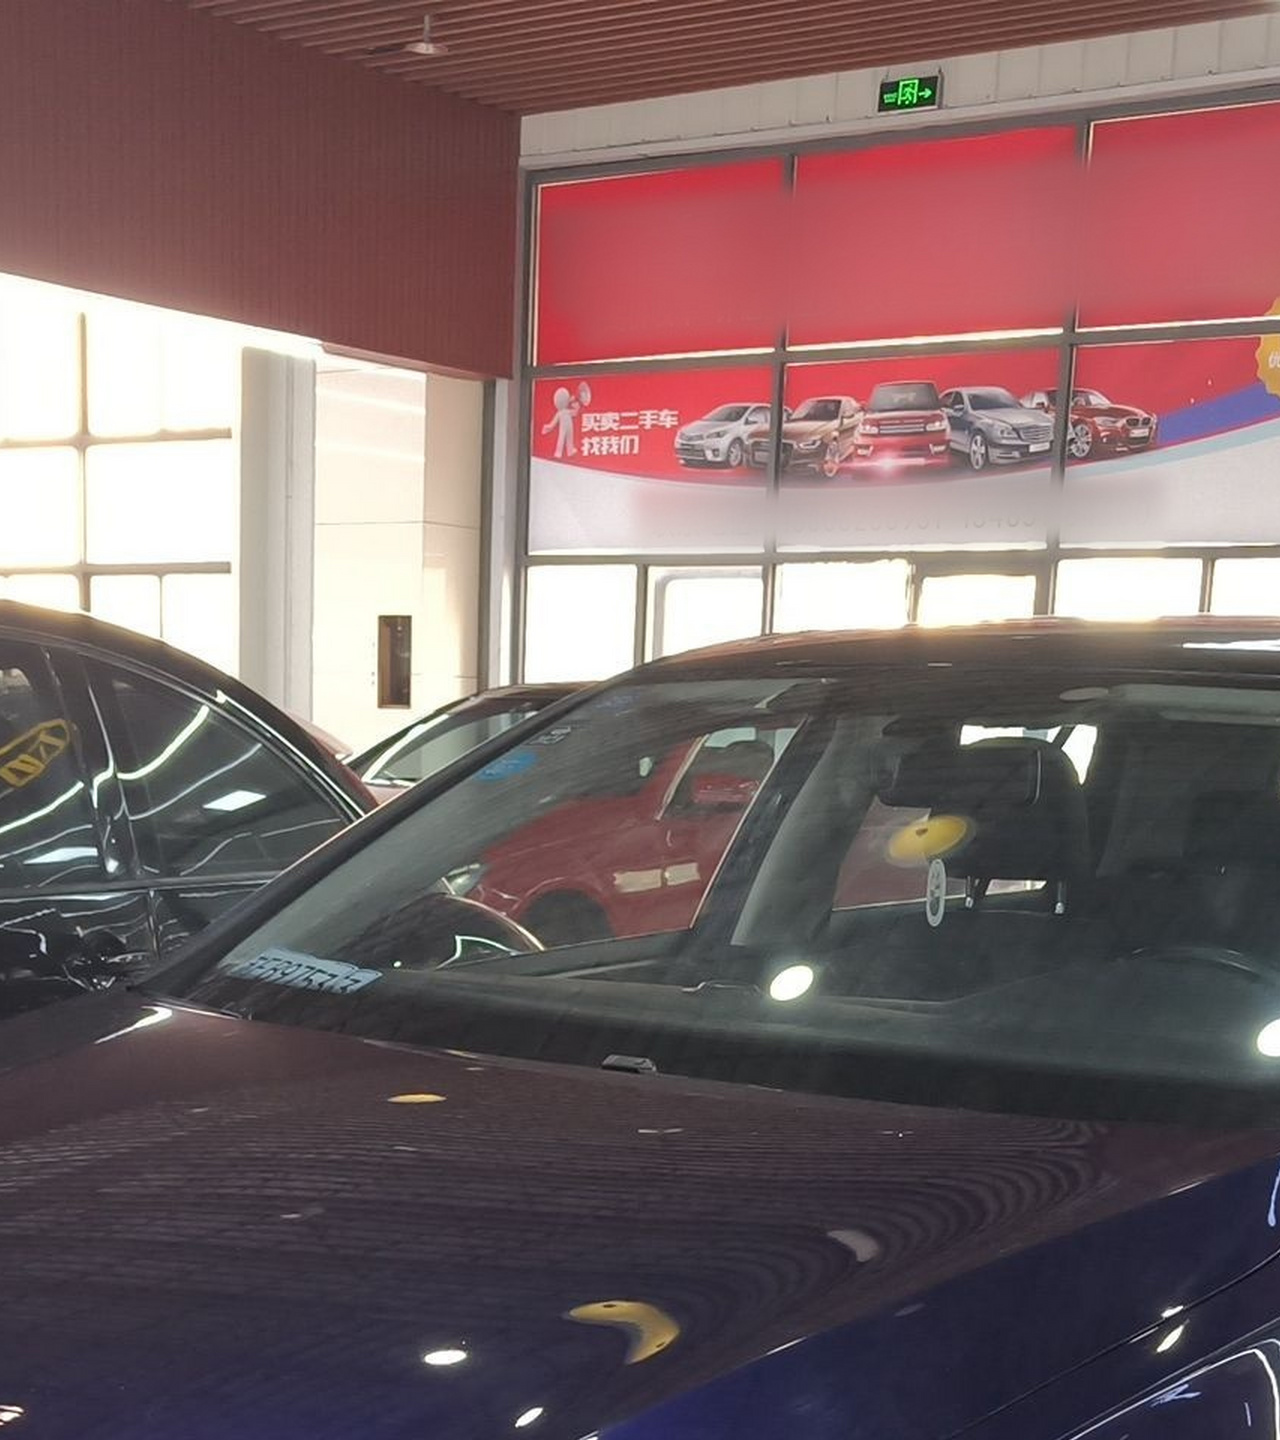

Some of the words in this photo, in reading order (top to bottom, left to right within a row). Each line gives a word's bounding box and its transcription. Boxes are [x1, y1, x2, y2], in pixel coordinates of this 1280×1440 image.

[581, 408, 679, 432] 买卖二手车
[581, 435, 639, 456] 找我们
